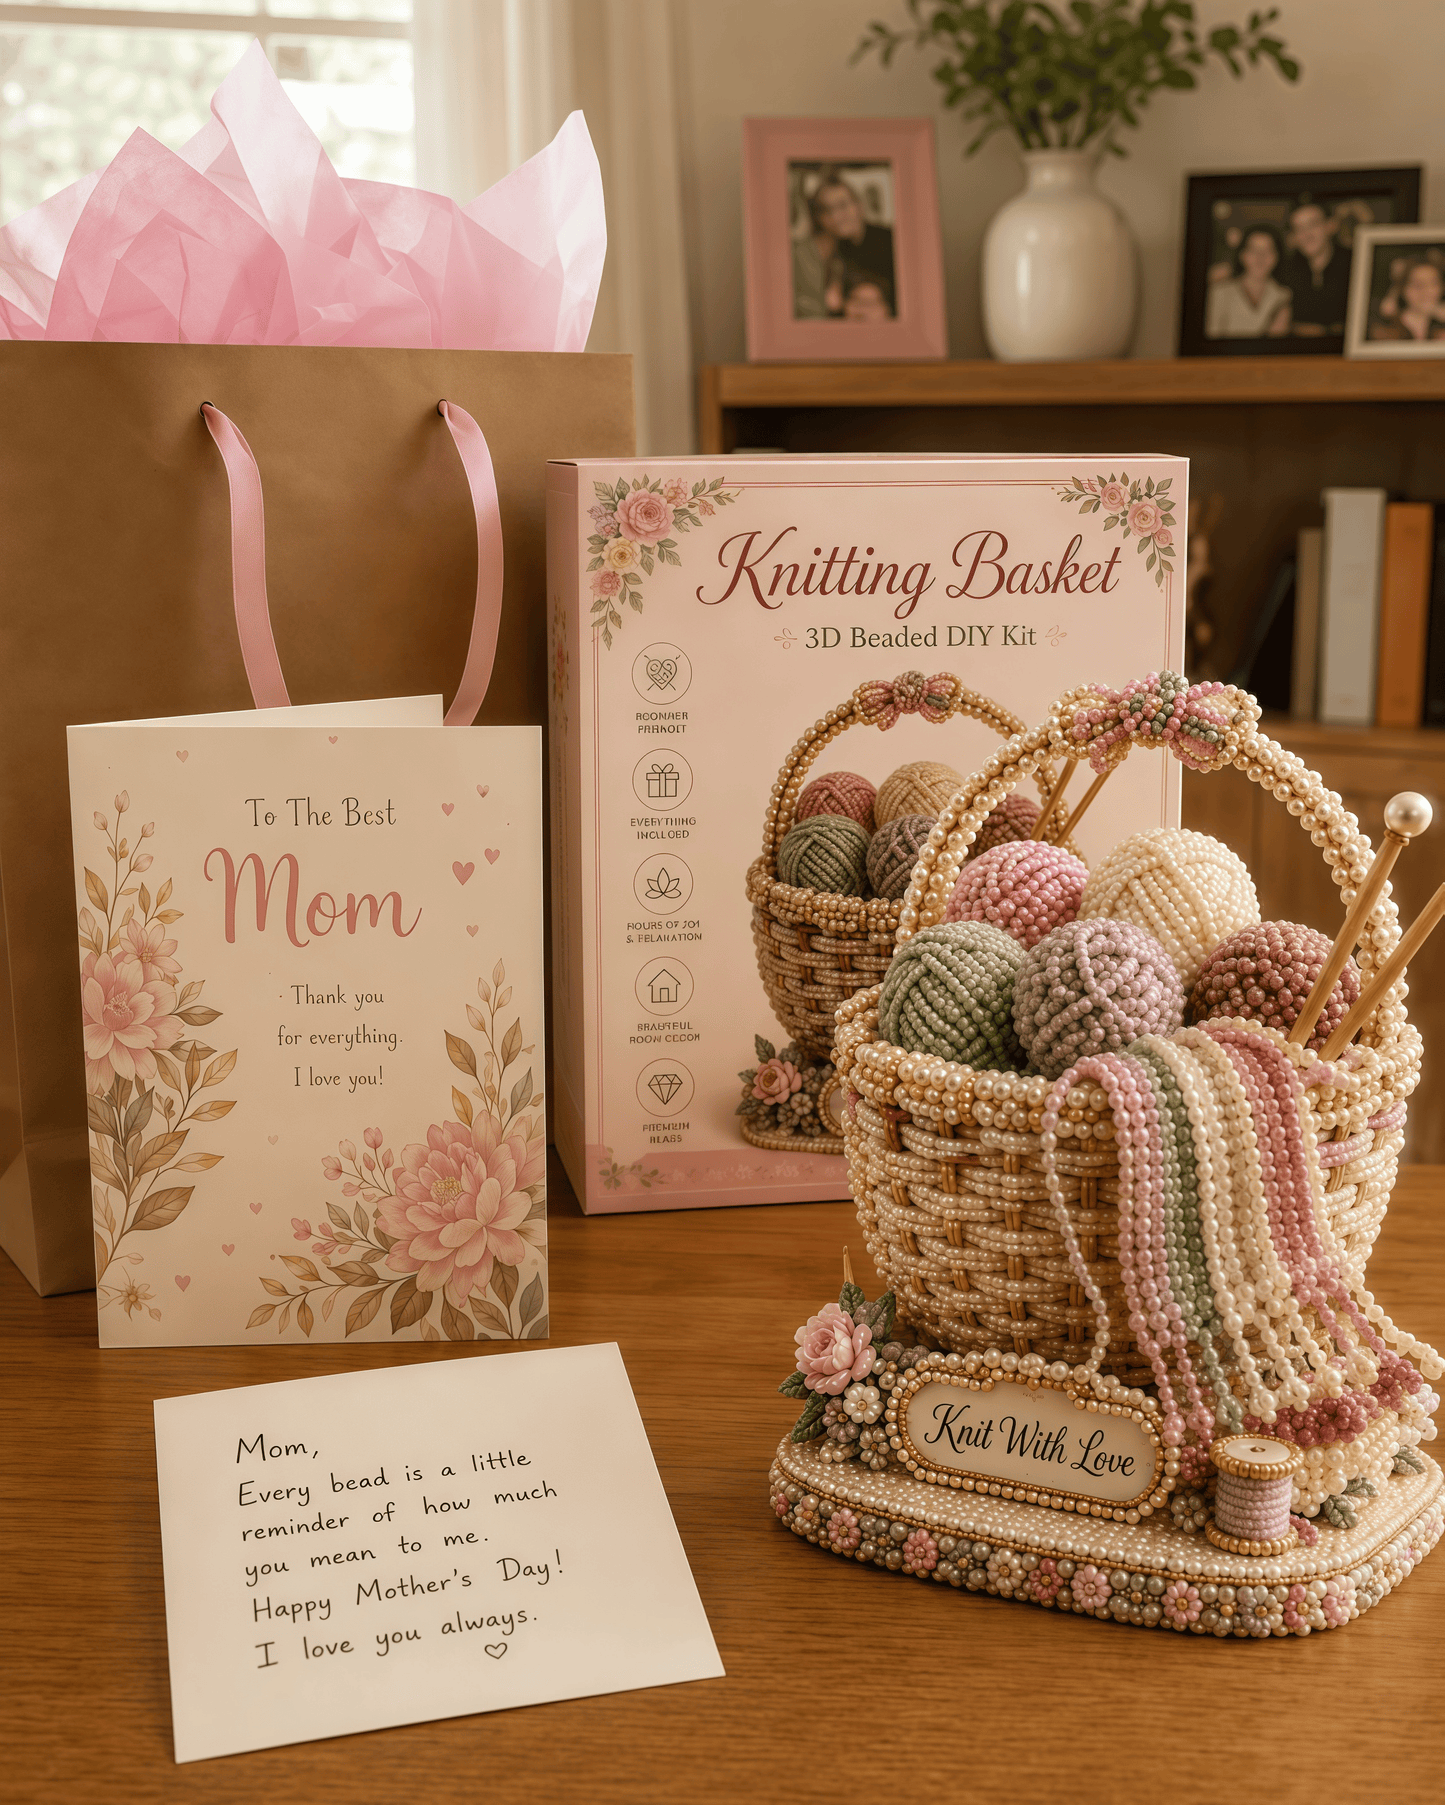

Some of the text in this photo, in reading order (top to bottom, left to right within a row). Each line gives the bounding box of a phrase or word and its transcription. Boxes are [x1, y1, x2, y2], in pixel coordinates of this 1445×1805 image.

[694, 525, 1122, 619] Knitting Basket
[805, 625, 1037, 649] 3D Beaded DIY Kit
[244, 796, 397, 827] To The Best
[203, 847, 423, 948] Mom
[290, 983, 385, 1012] Thank you
[277, 1023, 403, 1052] for everything.
[294, 1065, 383, 1094] I love you!
[236, 1433, 319, 1464] Mom,
[923, 1402, 1136, 1478] Knit With Love
[238, 1449, 532, 1507] Every bead is a little
[242, 1479, 558, 1542] reminder of how much
[245, 1532, 489, 1588] you mean to me.
[253, 1548, 563, 1624] Happy Mother's Day!
[254, 1610, 537, 1669] I love you always.
